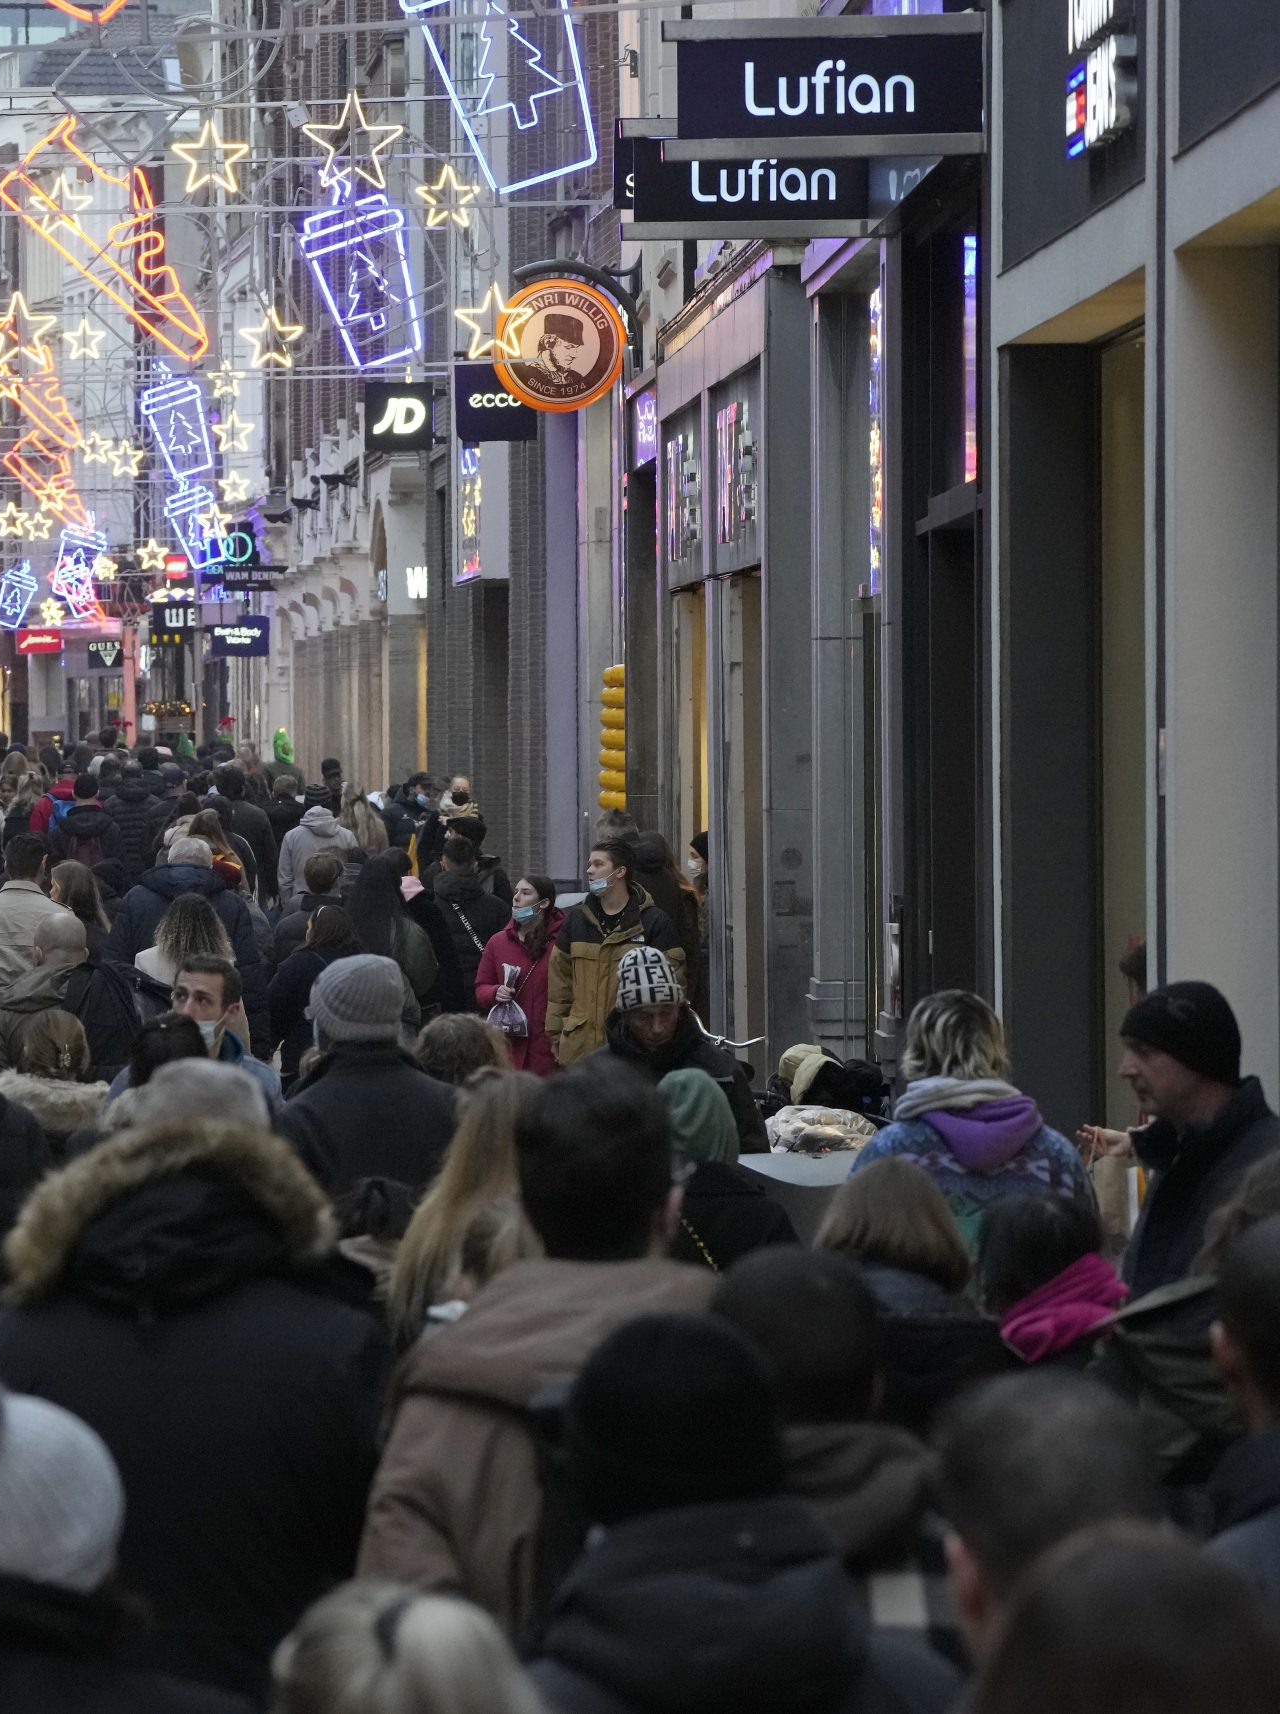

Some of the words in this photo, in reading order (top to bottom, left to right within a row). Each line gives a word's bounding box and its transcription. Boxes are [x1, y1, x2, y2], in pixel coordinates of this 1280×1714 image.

[744, 59, 915, 117] Lufian
[690, 159, 837, 202] Lufian
[517, 294, 559, 323] NRI
[565, 292, 608, 330] WILLIG
[469, 392, 521, 408] ecco
[527, 377, 556, 396] SINCE
[560, 381, 587, 396] 1974
[372, 397, 427, 434] JD
[88, 641, 121, 651] GUES
